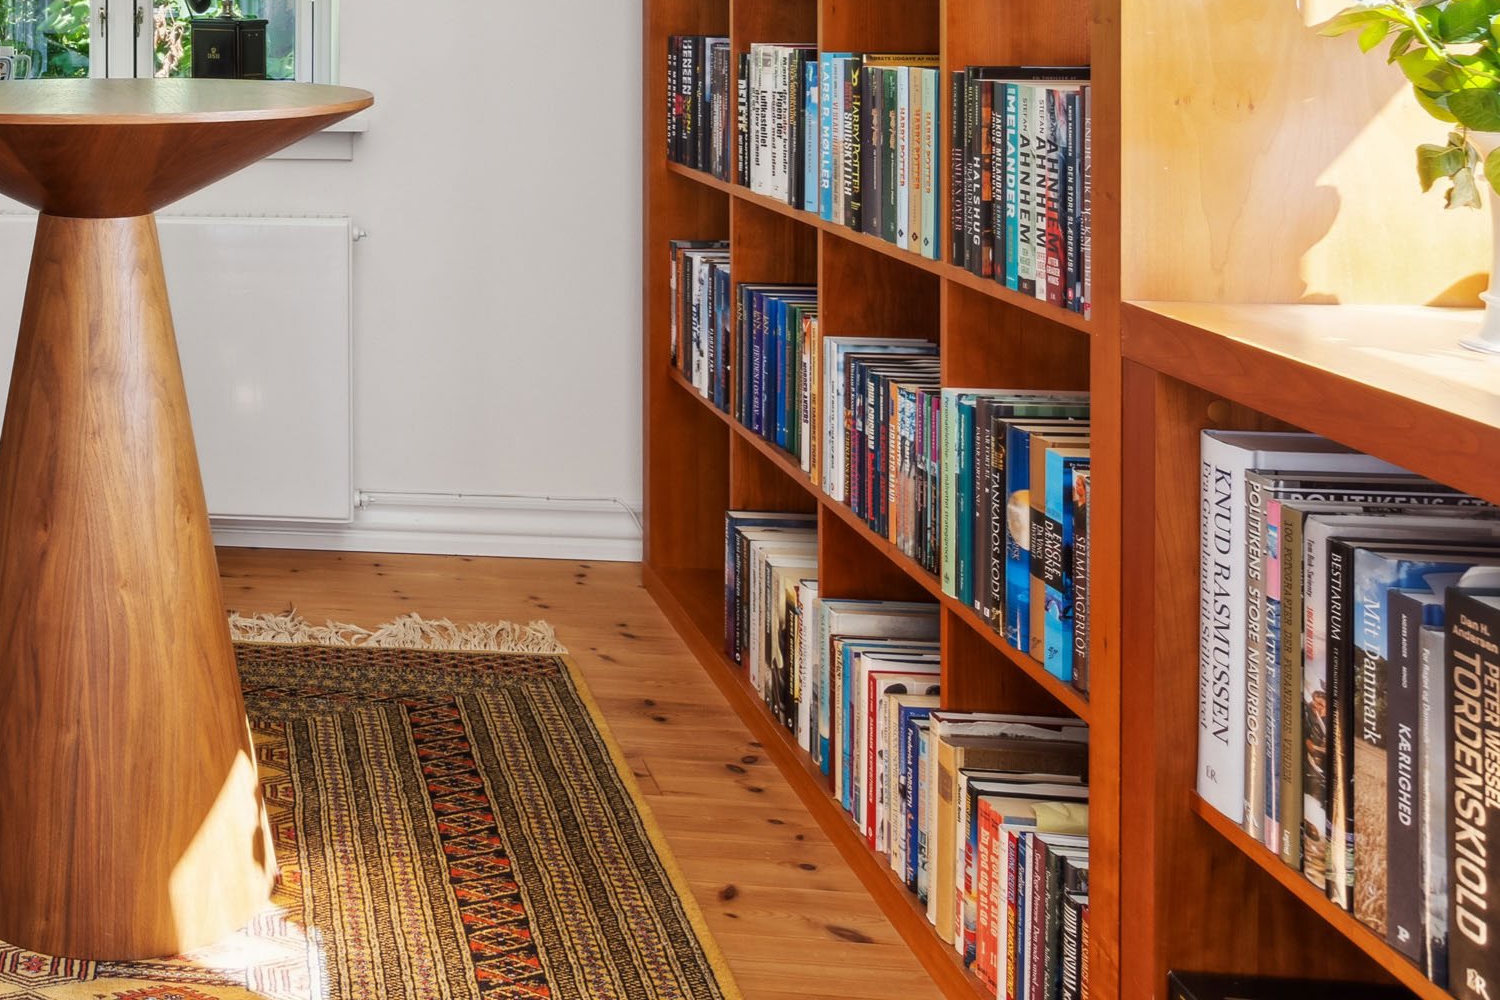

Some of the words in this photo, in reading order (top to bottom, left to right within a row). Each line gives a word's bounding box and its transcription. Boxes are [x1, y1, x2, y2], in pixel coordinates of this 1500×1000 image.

[821, 62, 830, 104] LARS
[821, 107, 830, 121] R.
[760, 90, 768, 147] Luftkastellet
[852, 95, 860, 142] HARRY
[821, 126, 830, 188] MØLLER
[852, 143, 860, 194] POTTER
[1007, 94, 1015, 217] MELANDER
[1020, 134, 1030, 243] AHNHEM
[1036, 136, 1046, 247] AHNHEM
[1047, 139, 1059, 254] AHNHEM
[1201, 462, 1211, 496] Fra
[1212, 466, 1232, 555] KNUD
[991, 473, 1000, 557] TANKADOS
[1201, 499, 1211, 593] Grønland
[1248, 481, 1260, 578] POLITIKENS
[991, 559, 1000, 600] KODE
[1044, 520, 1052, 579] DÆMONER
[1053, 534, 1062, 576] ENGLE
[1075, 535, 1085, 580] SELMA
[1075, 584, 1085, 657] LAGERLÖF
[1201, 599, 1211, 611] til
[1248, 585, 1260, 641] STORE
[1331, 553, 1341, 640] BESTIARIUM
[1363, 597, 1381, 642] Mit
[1201, 620, 1211, 731] Stillehavet
[1212, 561, 1232, 745] RASMUSSEN
[1248, 647, 1260, 745] NATURBOG
[1363, 646, 1381, 744] Danmark
[1484, 661, 1499, 724] PETER
[1398, 724, 1411, 825] KÆRLIGHED
[1453, 650, 1485, 944] TORDENSKIOLD
[1484, 730, 1499, 807] WESSEL
[1064, 905, 1076, 934] JOHN
[1064, 935, 1076, 990] GRISHAM
